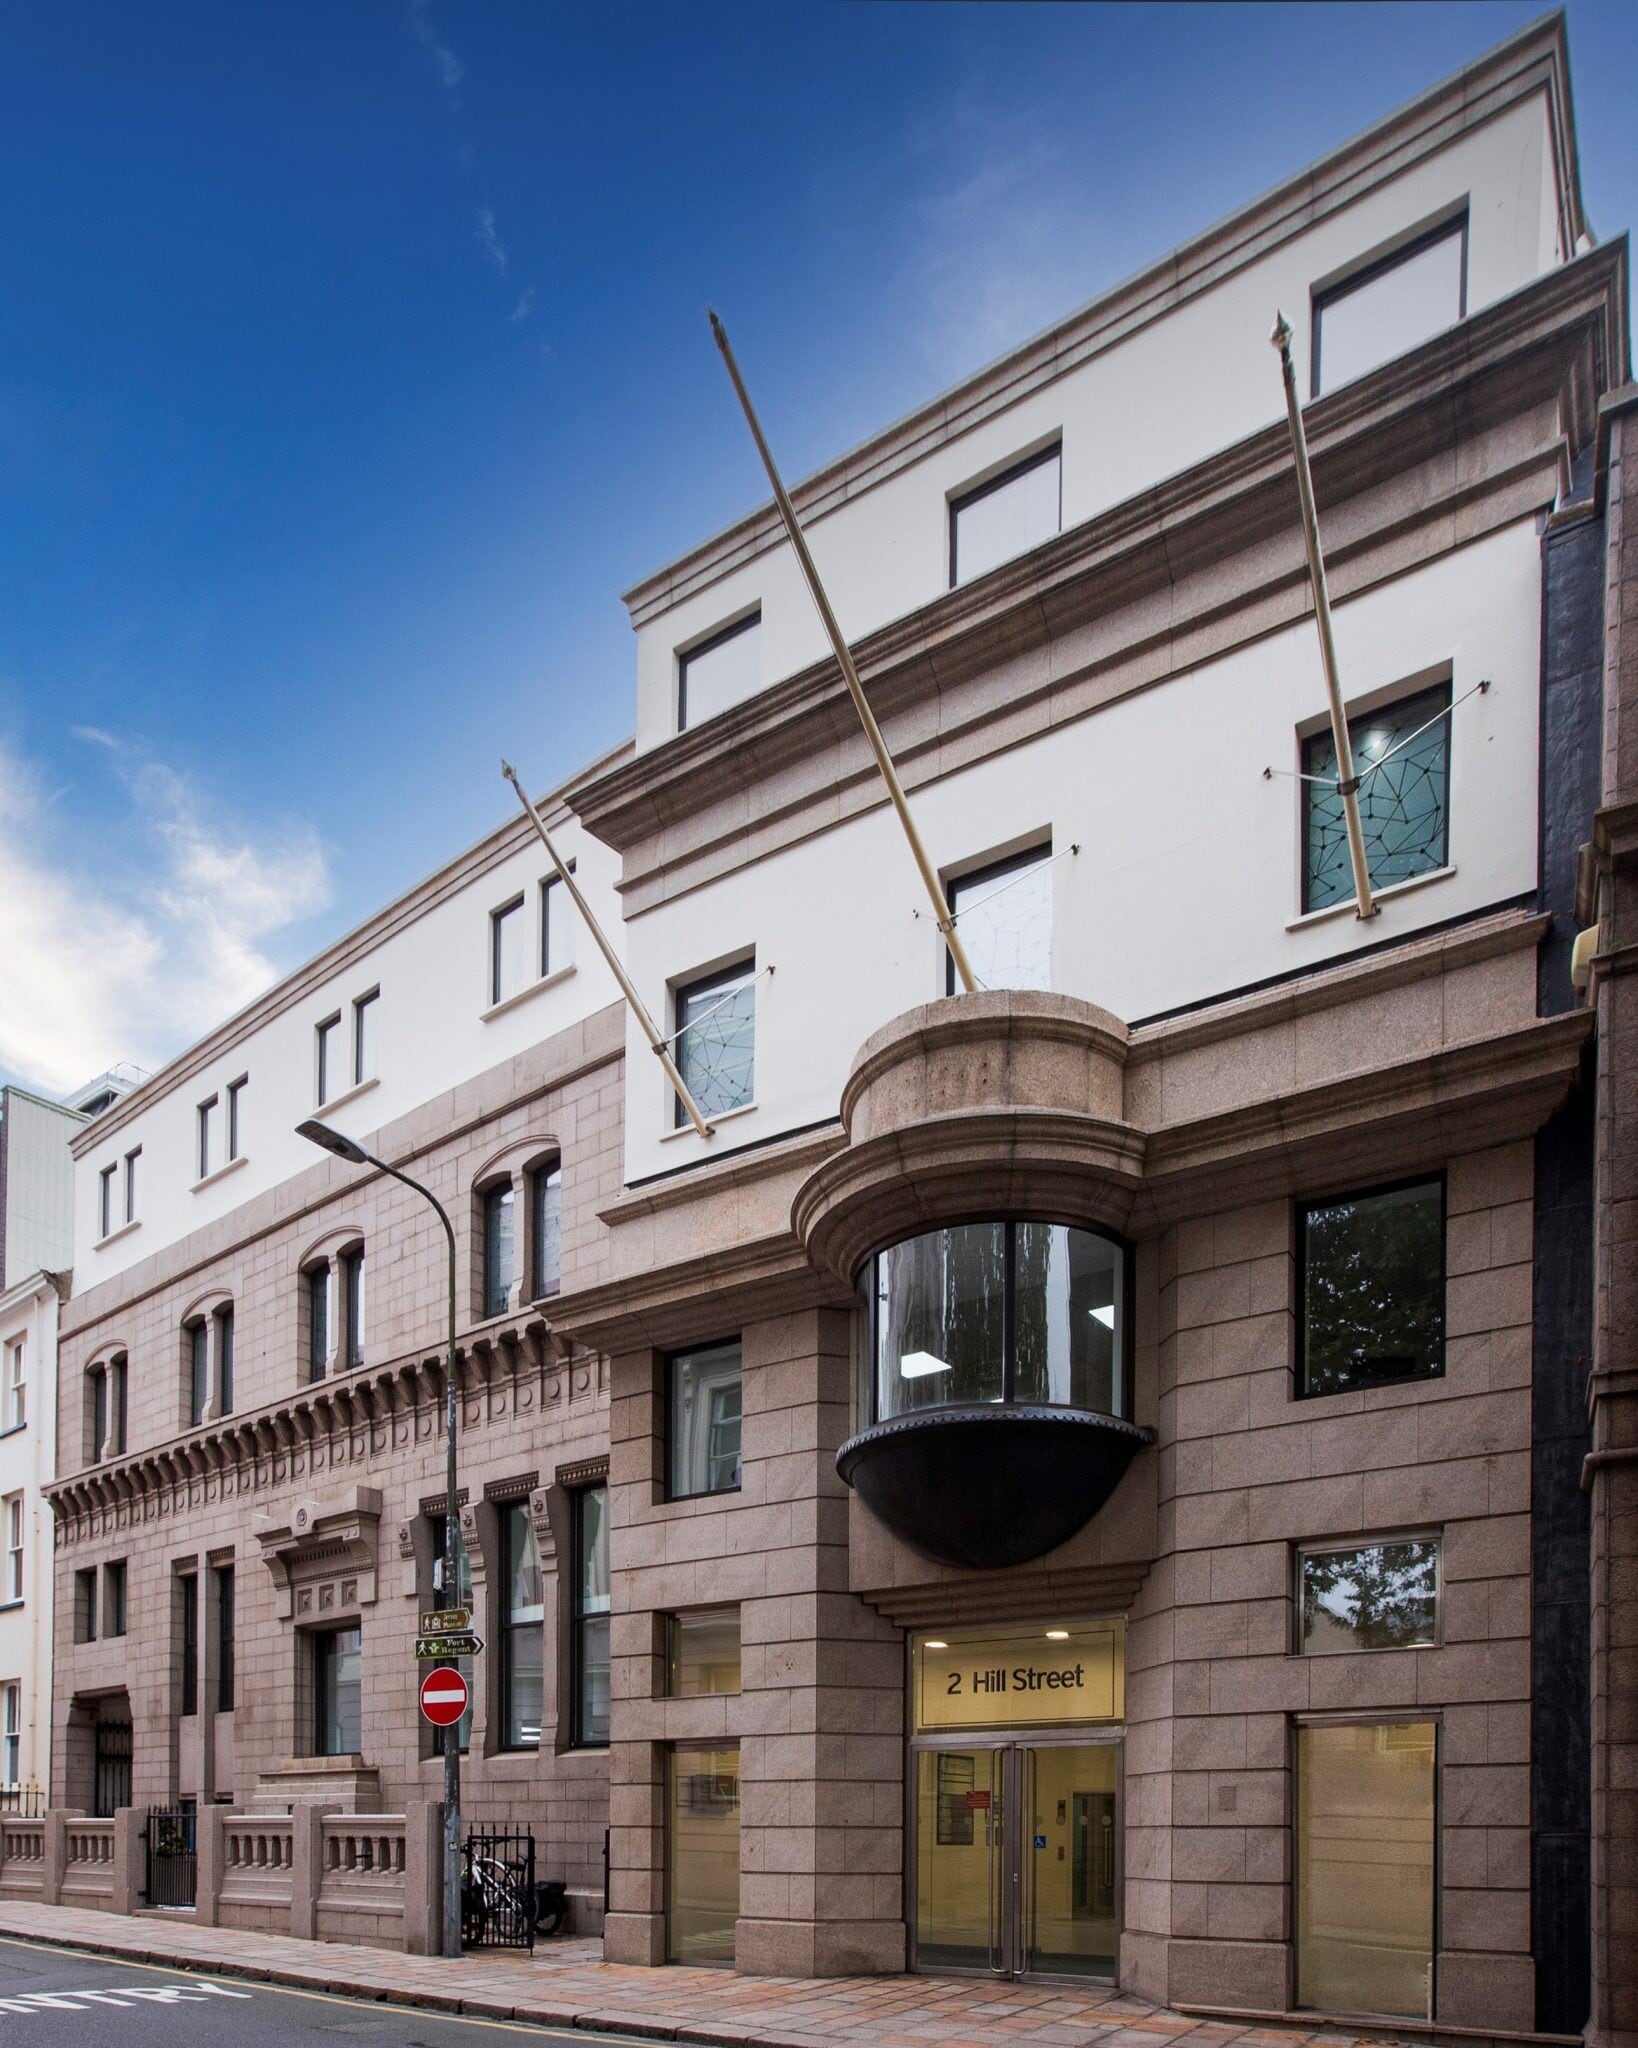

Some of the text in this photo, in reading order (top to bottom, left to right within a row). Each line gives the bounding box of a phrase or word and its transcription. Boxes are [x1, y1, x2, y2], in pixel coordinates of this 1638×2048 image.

[441, 1646, 471, 1655] Regent
[947, 1664, 1084, 1695] 2 Hill Street
[0, 1983, 252, 2014] NTRY
